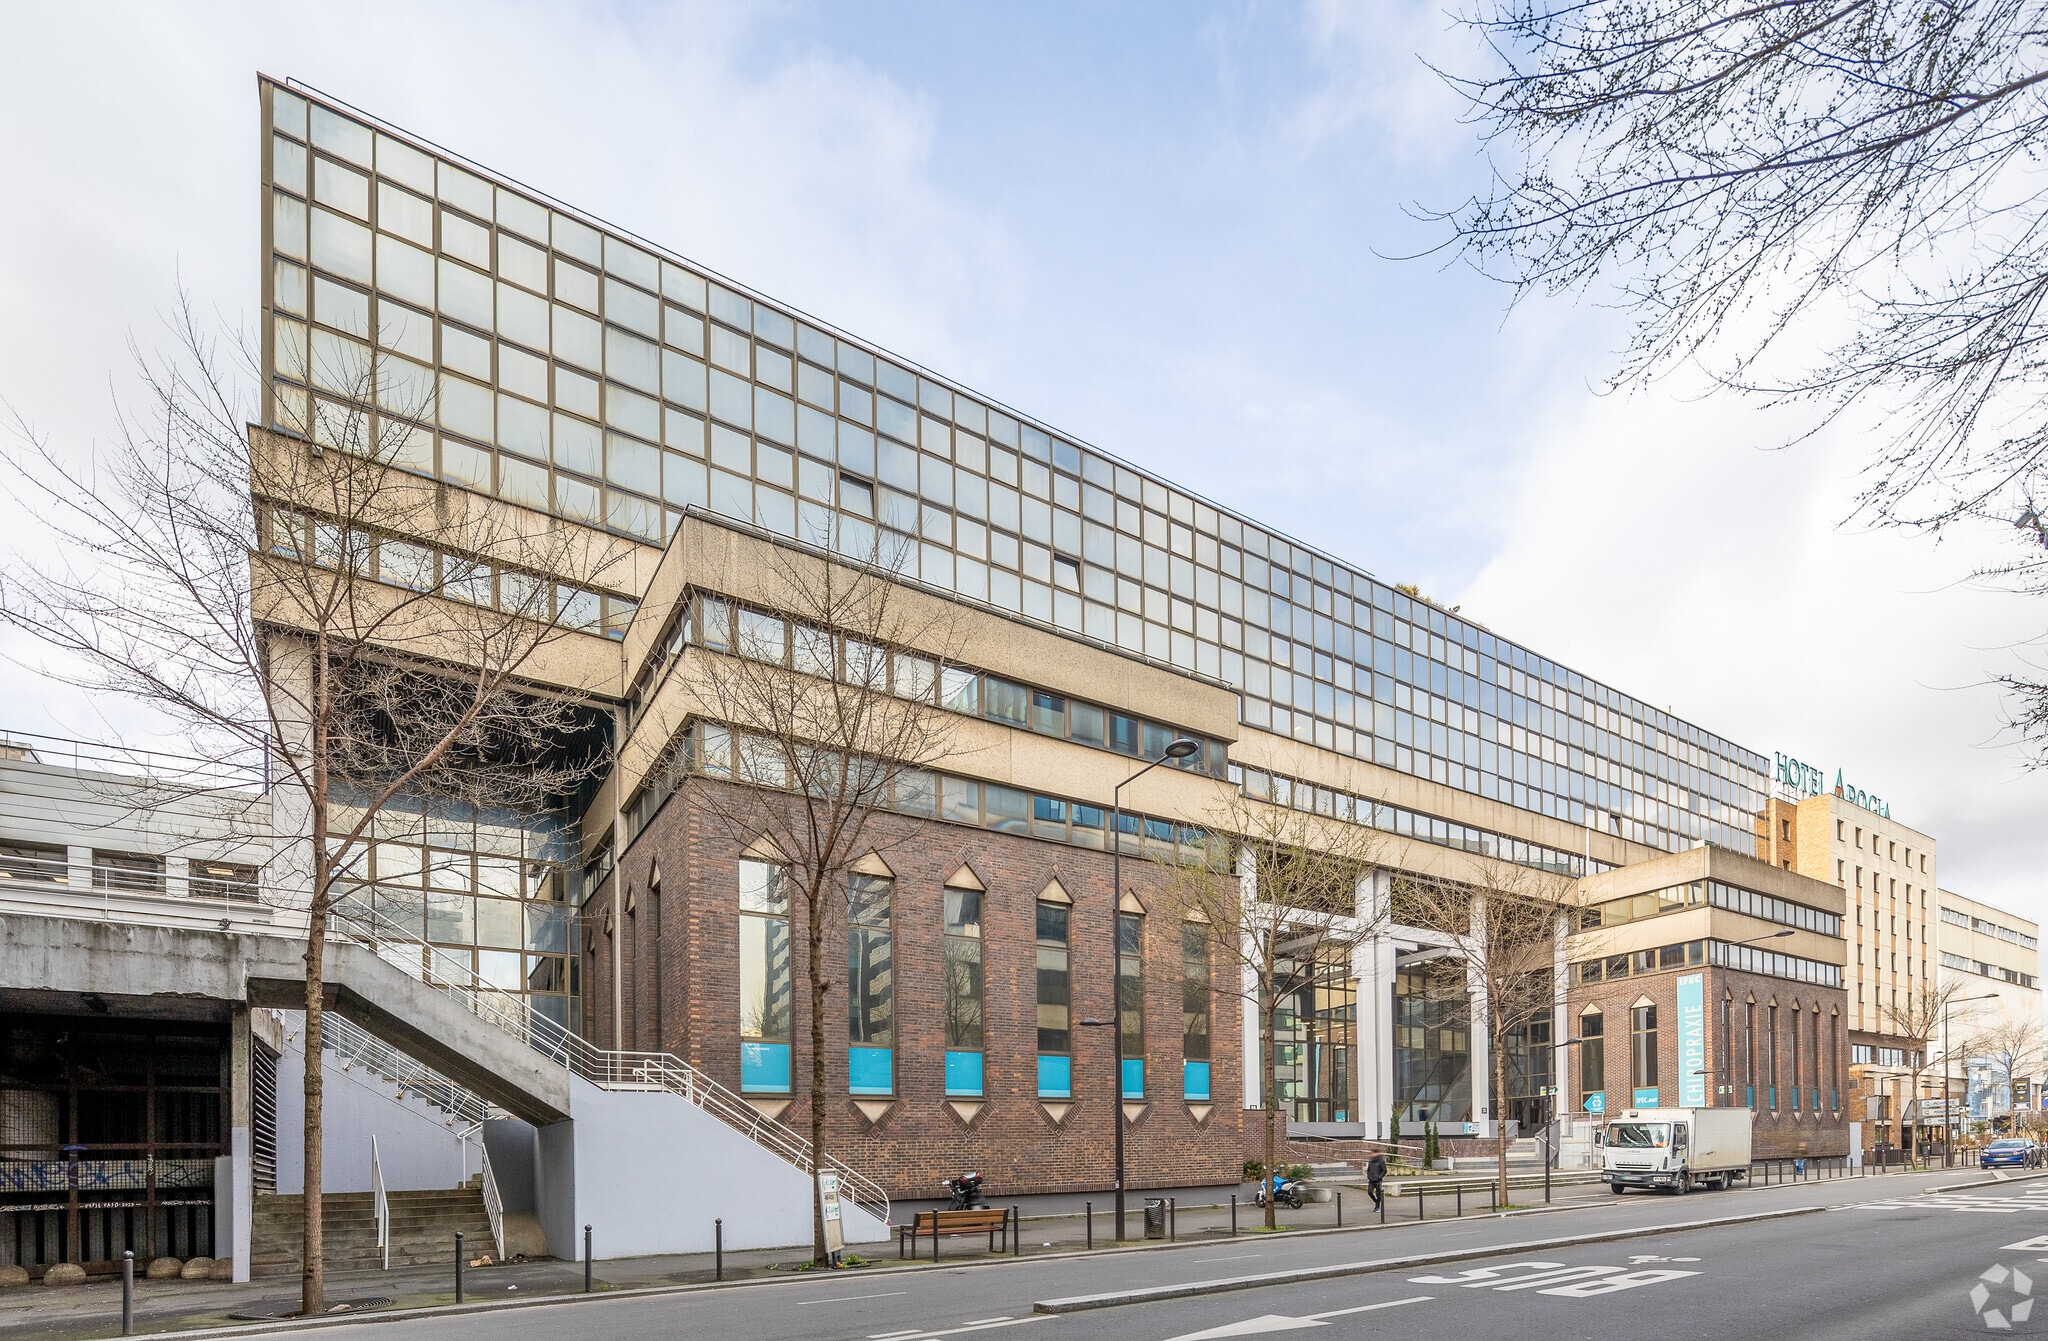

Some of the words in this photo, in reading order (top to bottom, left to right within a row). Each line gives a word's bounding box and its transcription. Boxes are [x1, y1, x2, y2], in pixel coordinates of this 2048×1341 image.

[1774, 751, 1824, 796] HOTEL
[1834, 767, 1891, 820] APOGIA
[1679, 976, 1701, 986] IFEC
[1685, 1004, 1703, 1102] CHIROPRAXIE
[1407, 1261, 1704, 1297] BUS
